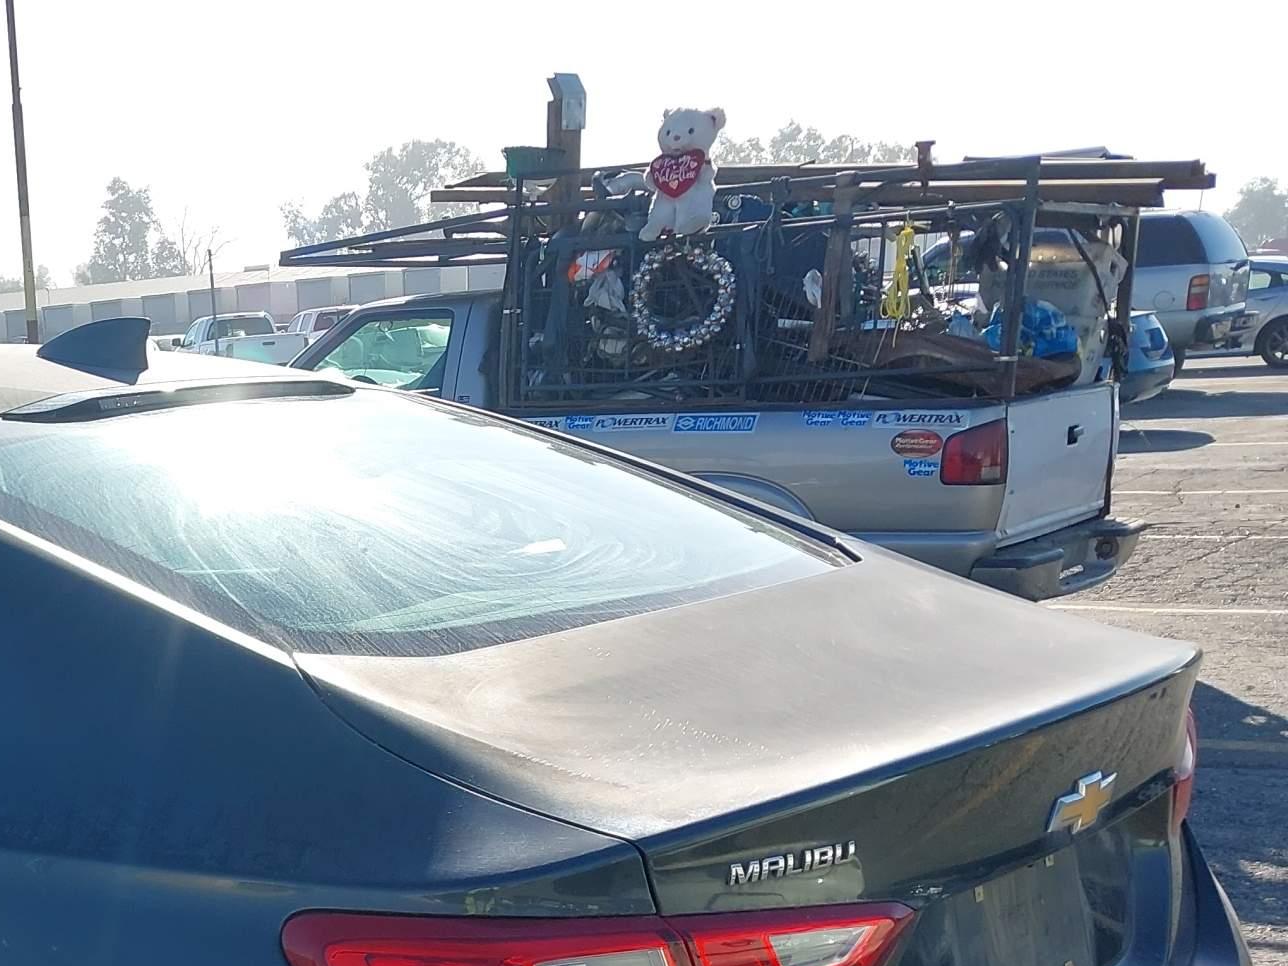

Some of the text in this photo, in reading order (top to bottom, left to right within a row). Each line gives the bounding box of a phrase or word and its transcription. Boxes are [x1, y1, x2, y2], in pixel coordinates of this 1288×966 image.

[802, 410, 836, 420] Motive
[837, 410, 872, 420] Motive
[875, 412, 963, 424] POWERTRAX
[595, 416, 668, 427] POWERTRAX
[695, 415, 755, 430] RICHMOND
[806, 418, 832, 427] Gear
[841, 418, 867, 426] Gear
[903, 459, 940, 469] Motive
[908, 468, 935, 477] Gear
[729, 840, 855, 886] MALIBU
